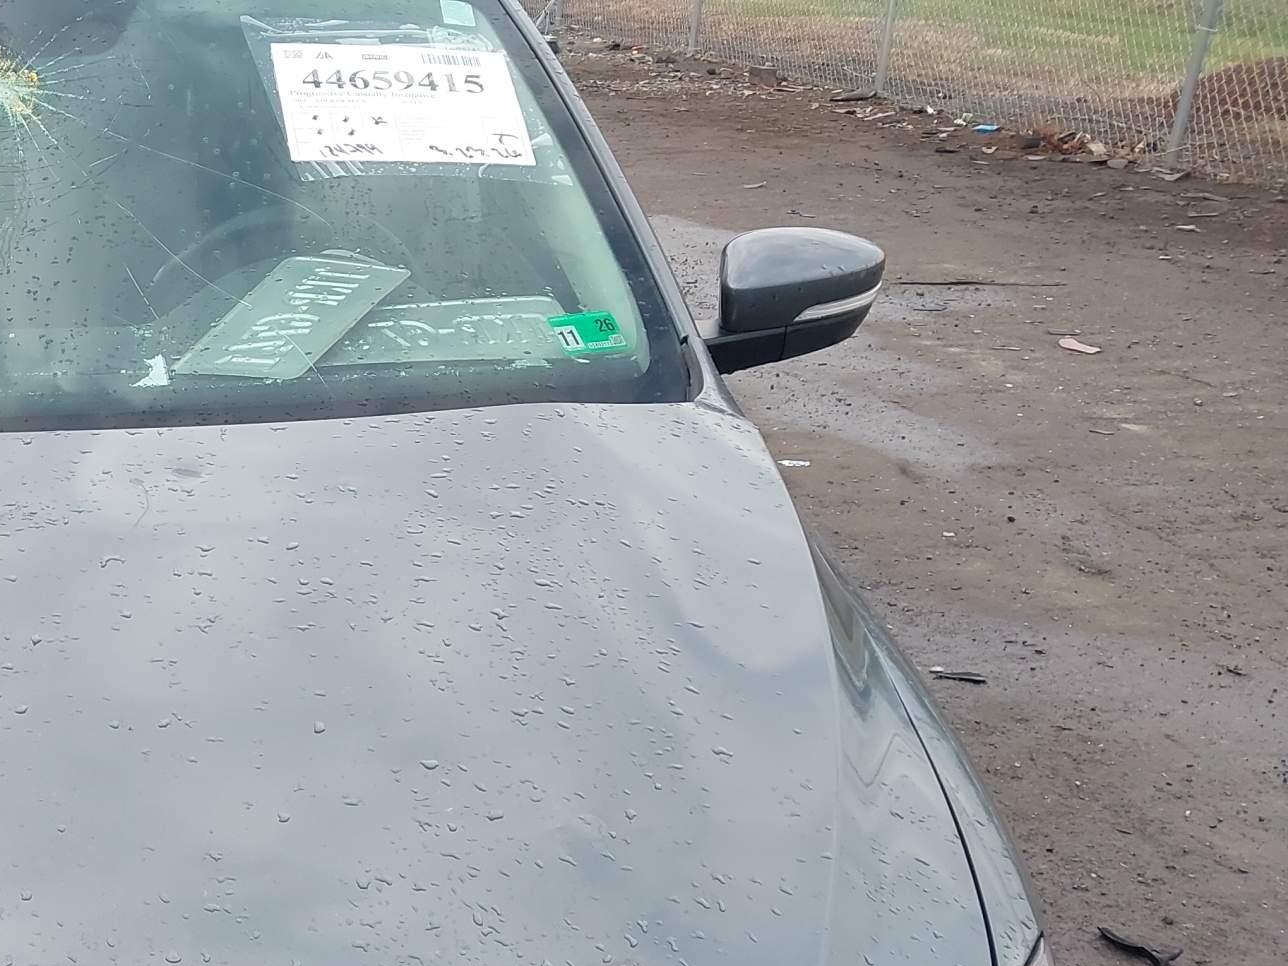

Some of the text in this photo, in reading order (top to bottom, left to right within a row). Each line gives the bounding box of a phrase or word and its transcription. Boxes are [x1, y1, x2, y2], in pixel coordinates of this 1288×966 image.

[301, 67, 486, 95] 44659415
[595, 318, 616, 333] 26
[557, 329, 581, 347] 11
